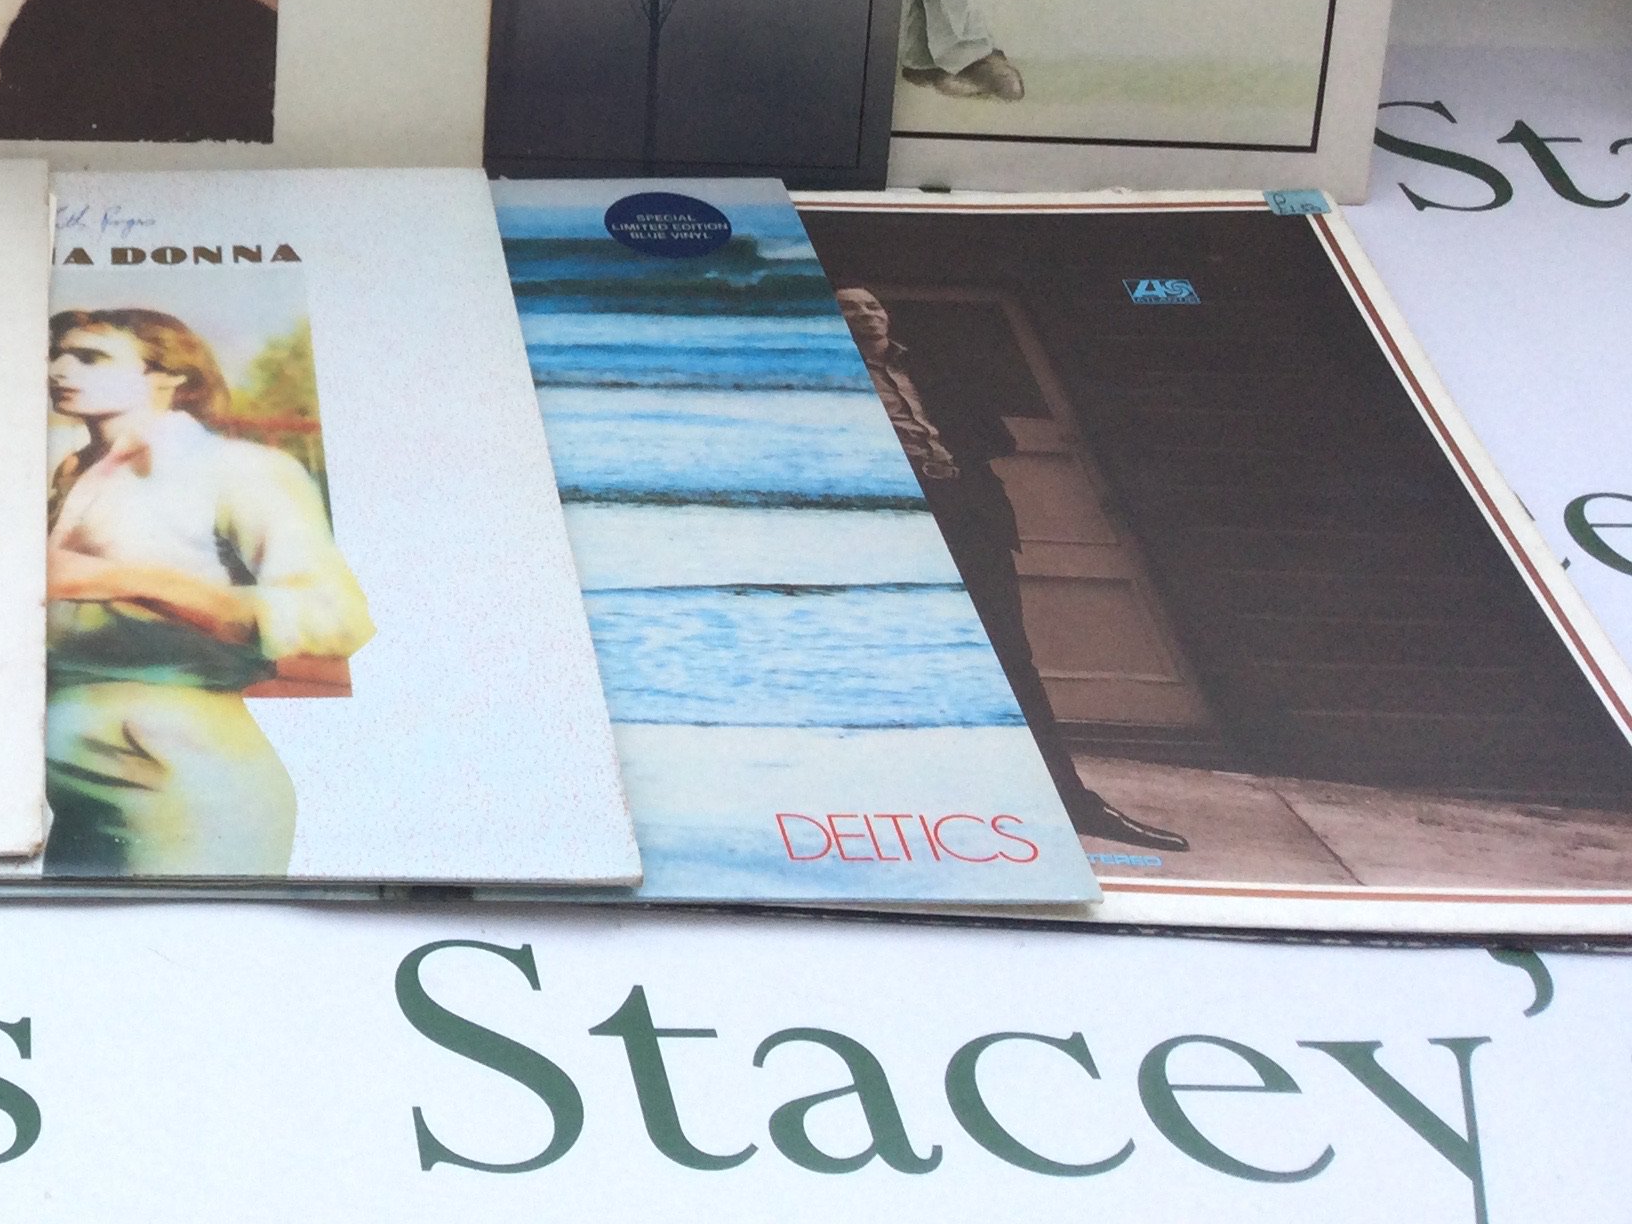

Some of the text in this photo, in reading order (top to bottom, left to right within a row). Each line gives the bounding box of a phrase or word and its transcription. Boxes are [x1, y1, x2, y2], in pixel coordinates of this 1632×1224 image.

[1373, 99, 1632, 212] St
[635, 213, 697, 223] SPECIAL
[611, 222, 729, 232] LIMITED EDITION
[630, 231, 712, 240] BLUE VINYL
[110, 243, 303, 266] DONNA
[775, 813, 1040, 864] DELTICS
[1085, 852, 1163, 867] TEREO
